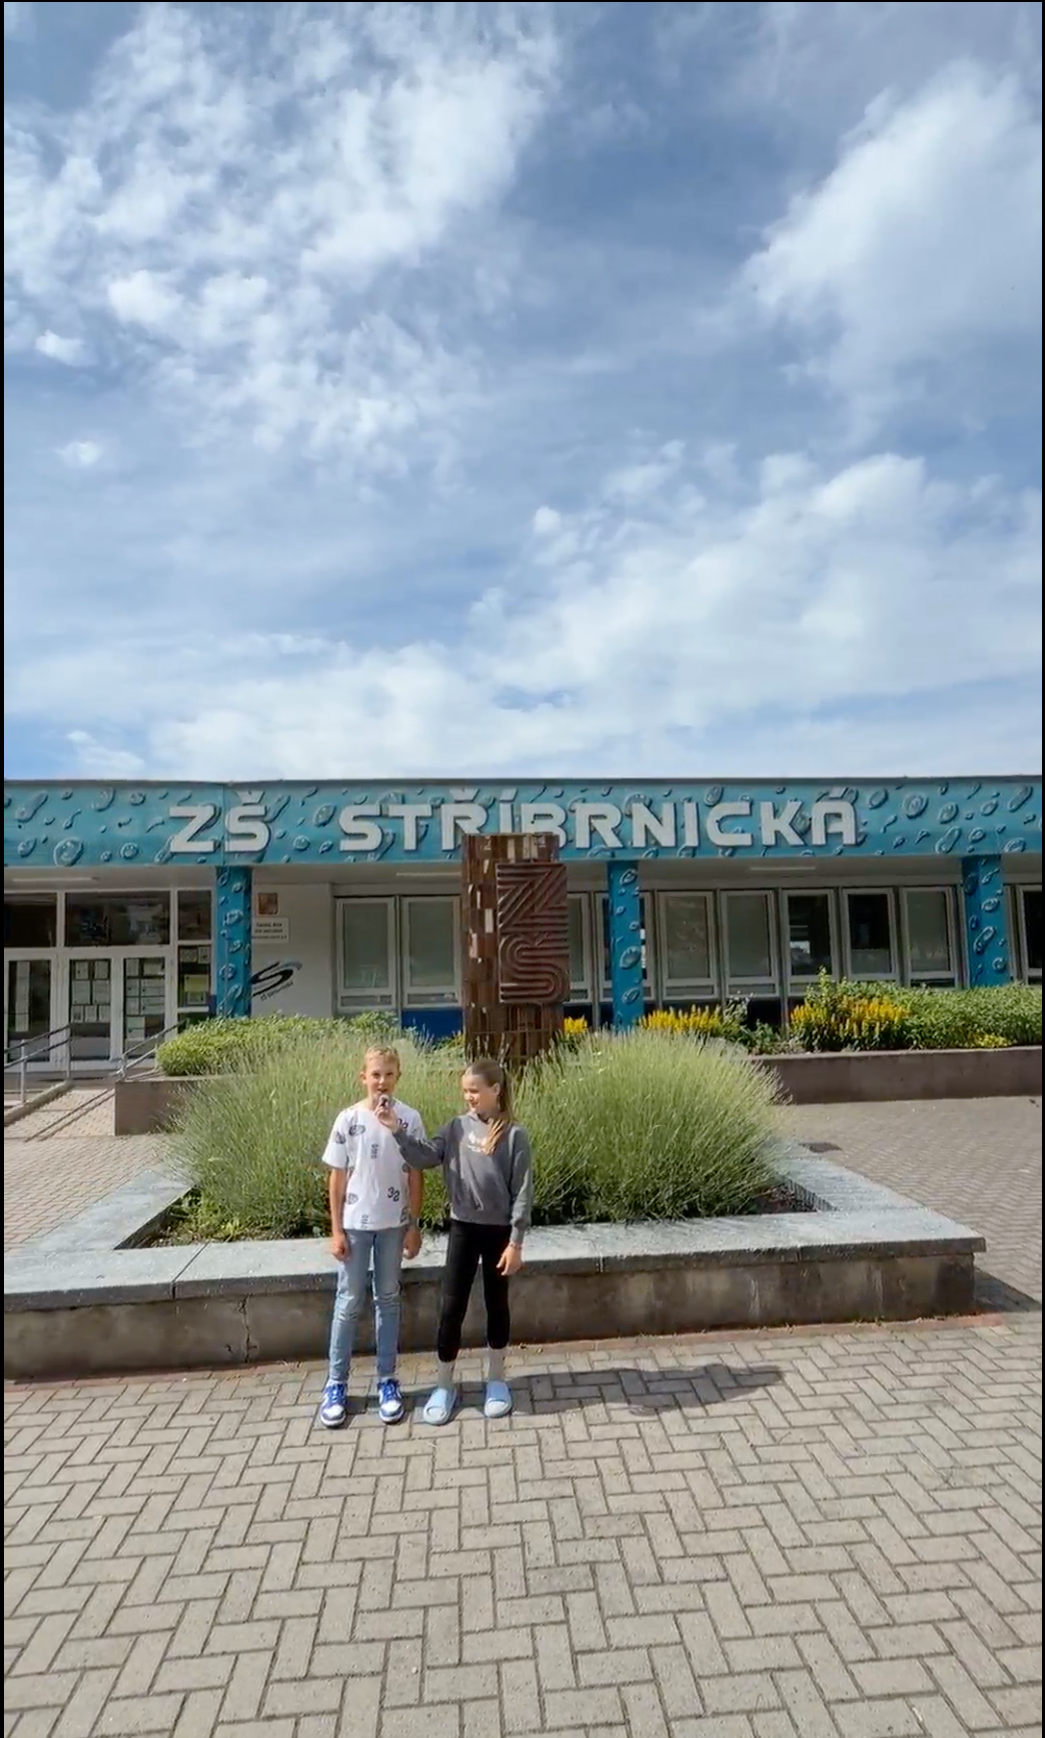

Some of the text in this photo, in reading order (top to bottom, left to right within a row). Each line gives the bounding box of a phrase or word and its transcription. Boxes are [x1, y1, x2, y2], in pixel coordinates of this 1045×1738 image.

[168, 787, 857, 853] ZŠ STŘÍBRNICKÁ
[387, 1186, 401, 1202] 32
